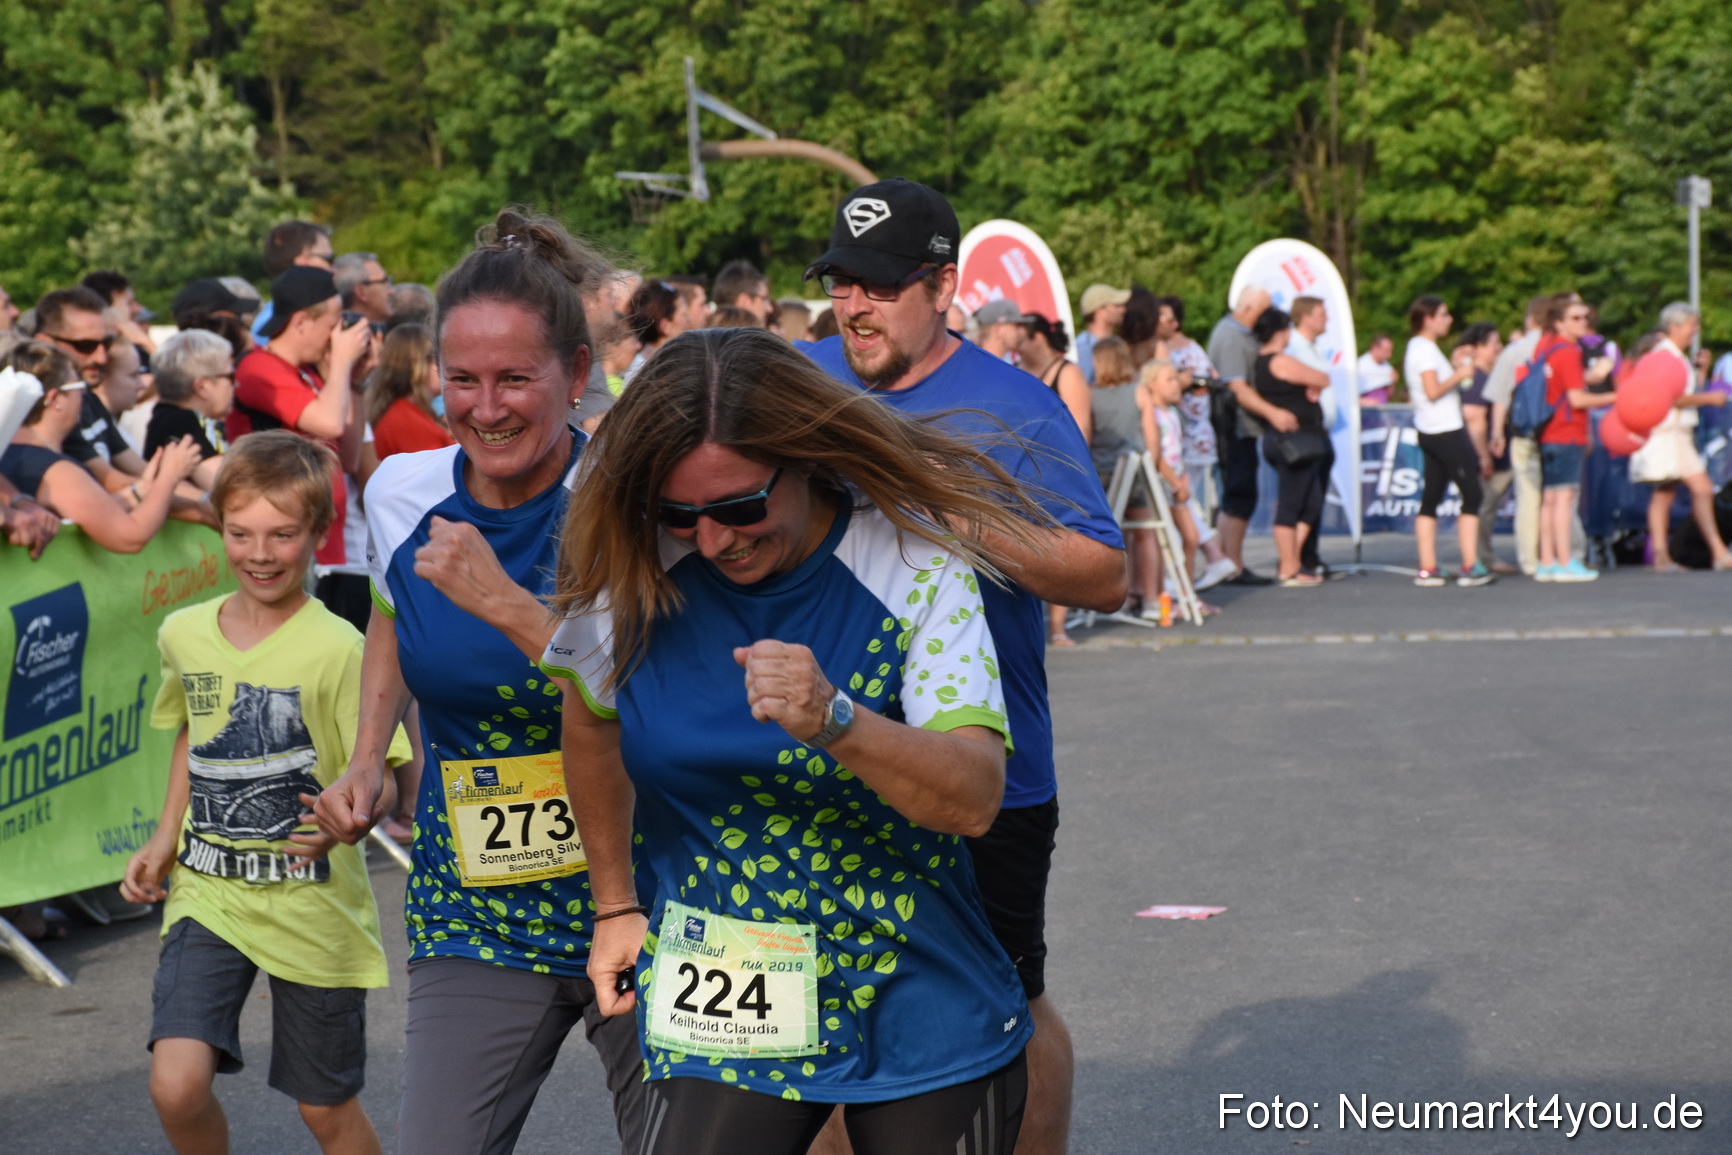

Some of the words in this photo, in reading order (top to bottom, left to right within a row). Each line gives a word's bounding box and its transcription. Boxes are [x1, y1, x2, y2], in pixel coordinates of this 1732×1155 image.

[25, 632, 80, 668] Fischer
[466, 781, 524, 798] firmenlauf
[534, 782, 563, 799] walk
[480, 799, 575, 850] 273
[184, 838, 229, 877] BUILT
[235, 852, 259, 881] TO
[479, 847, 555, 866] Sonnenberg
[556, 841, 582, 855] Silv
[509, 861, 551, 873] Bionorica
[551, 856, 565, 866] SE
[674, 934, 727, 959] firmenlauf
[741, 959, 763, 970] run
[768, 961, 803, 972] 2019
[673, 962, 772, 1020] 224
[670, 1012, 719, 1033] Keilhold
[723, 1021, 779, 1034] Claudia
[689, 1032, 733, 1045] Bionorica
[736, 1036, 751, 1045] SE
